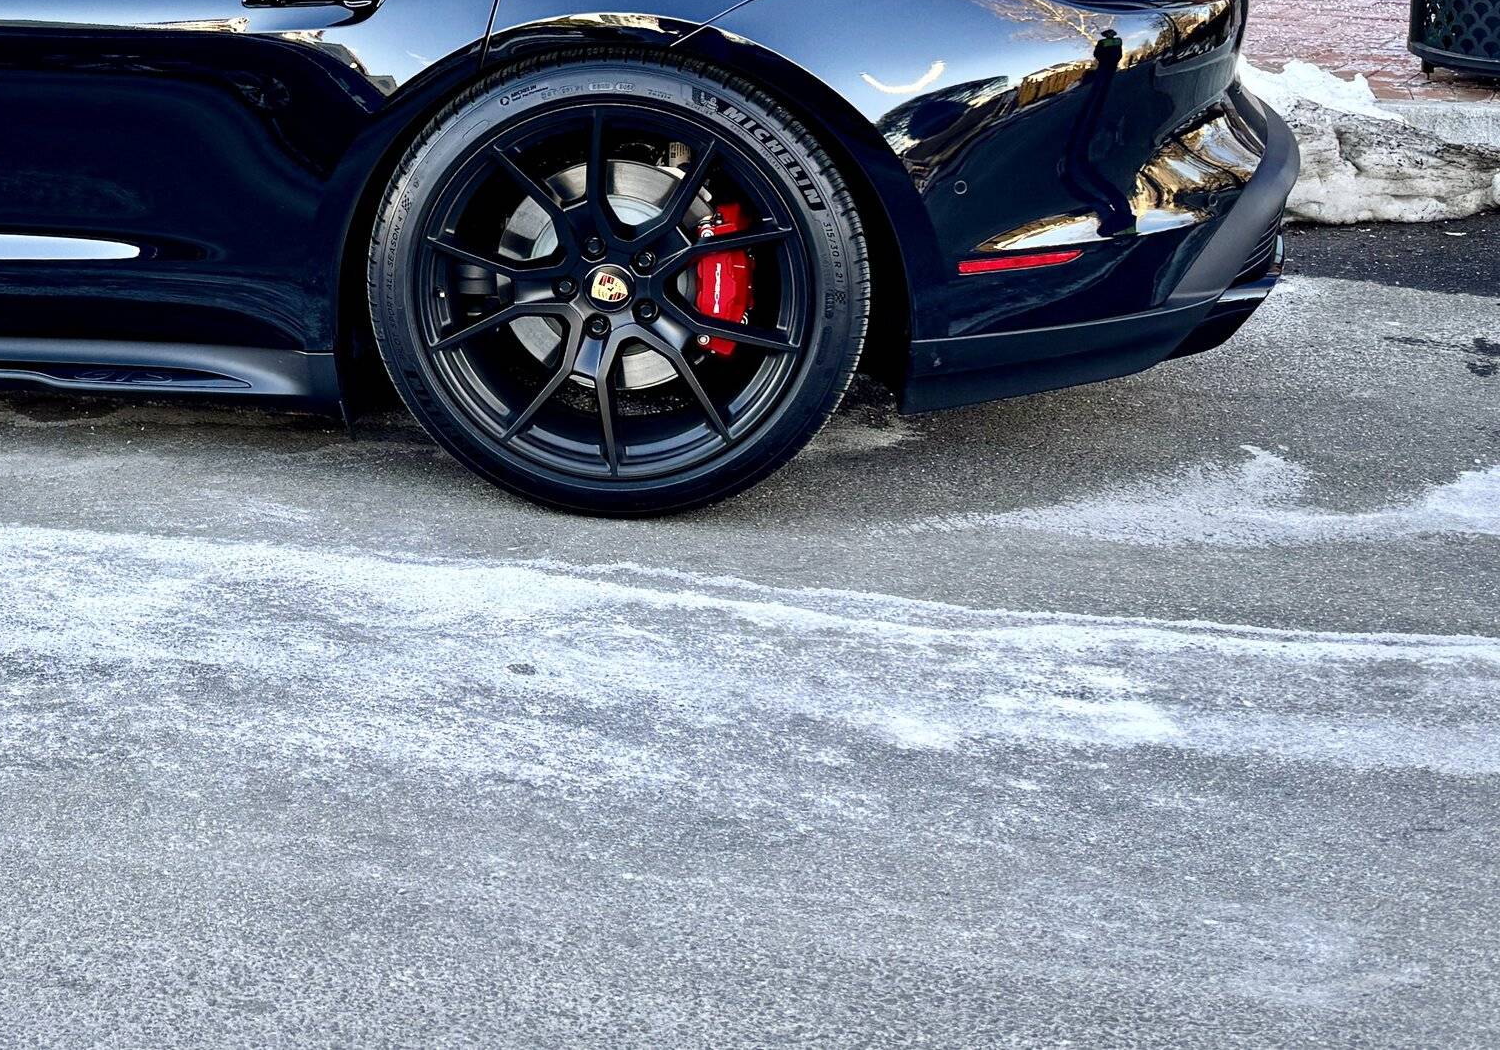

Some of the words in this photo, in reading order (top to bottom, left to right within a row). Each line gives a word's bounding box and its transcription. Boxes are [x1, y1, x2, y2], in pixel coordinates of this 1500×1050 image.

[723, 106, 821, 204] MICHELIN
[388, 225, 401, 267] SEASON
[823, 222, 840, 257] 315/30
[835, 272, 844, 283] 21
